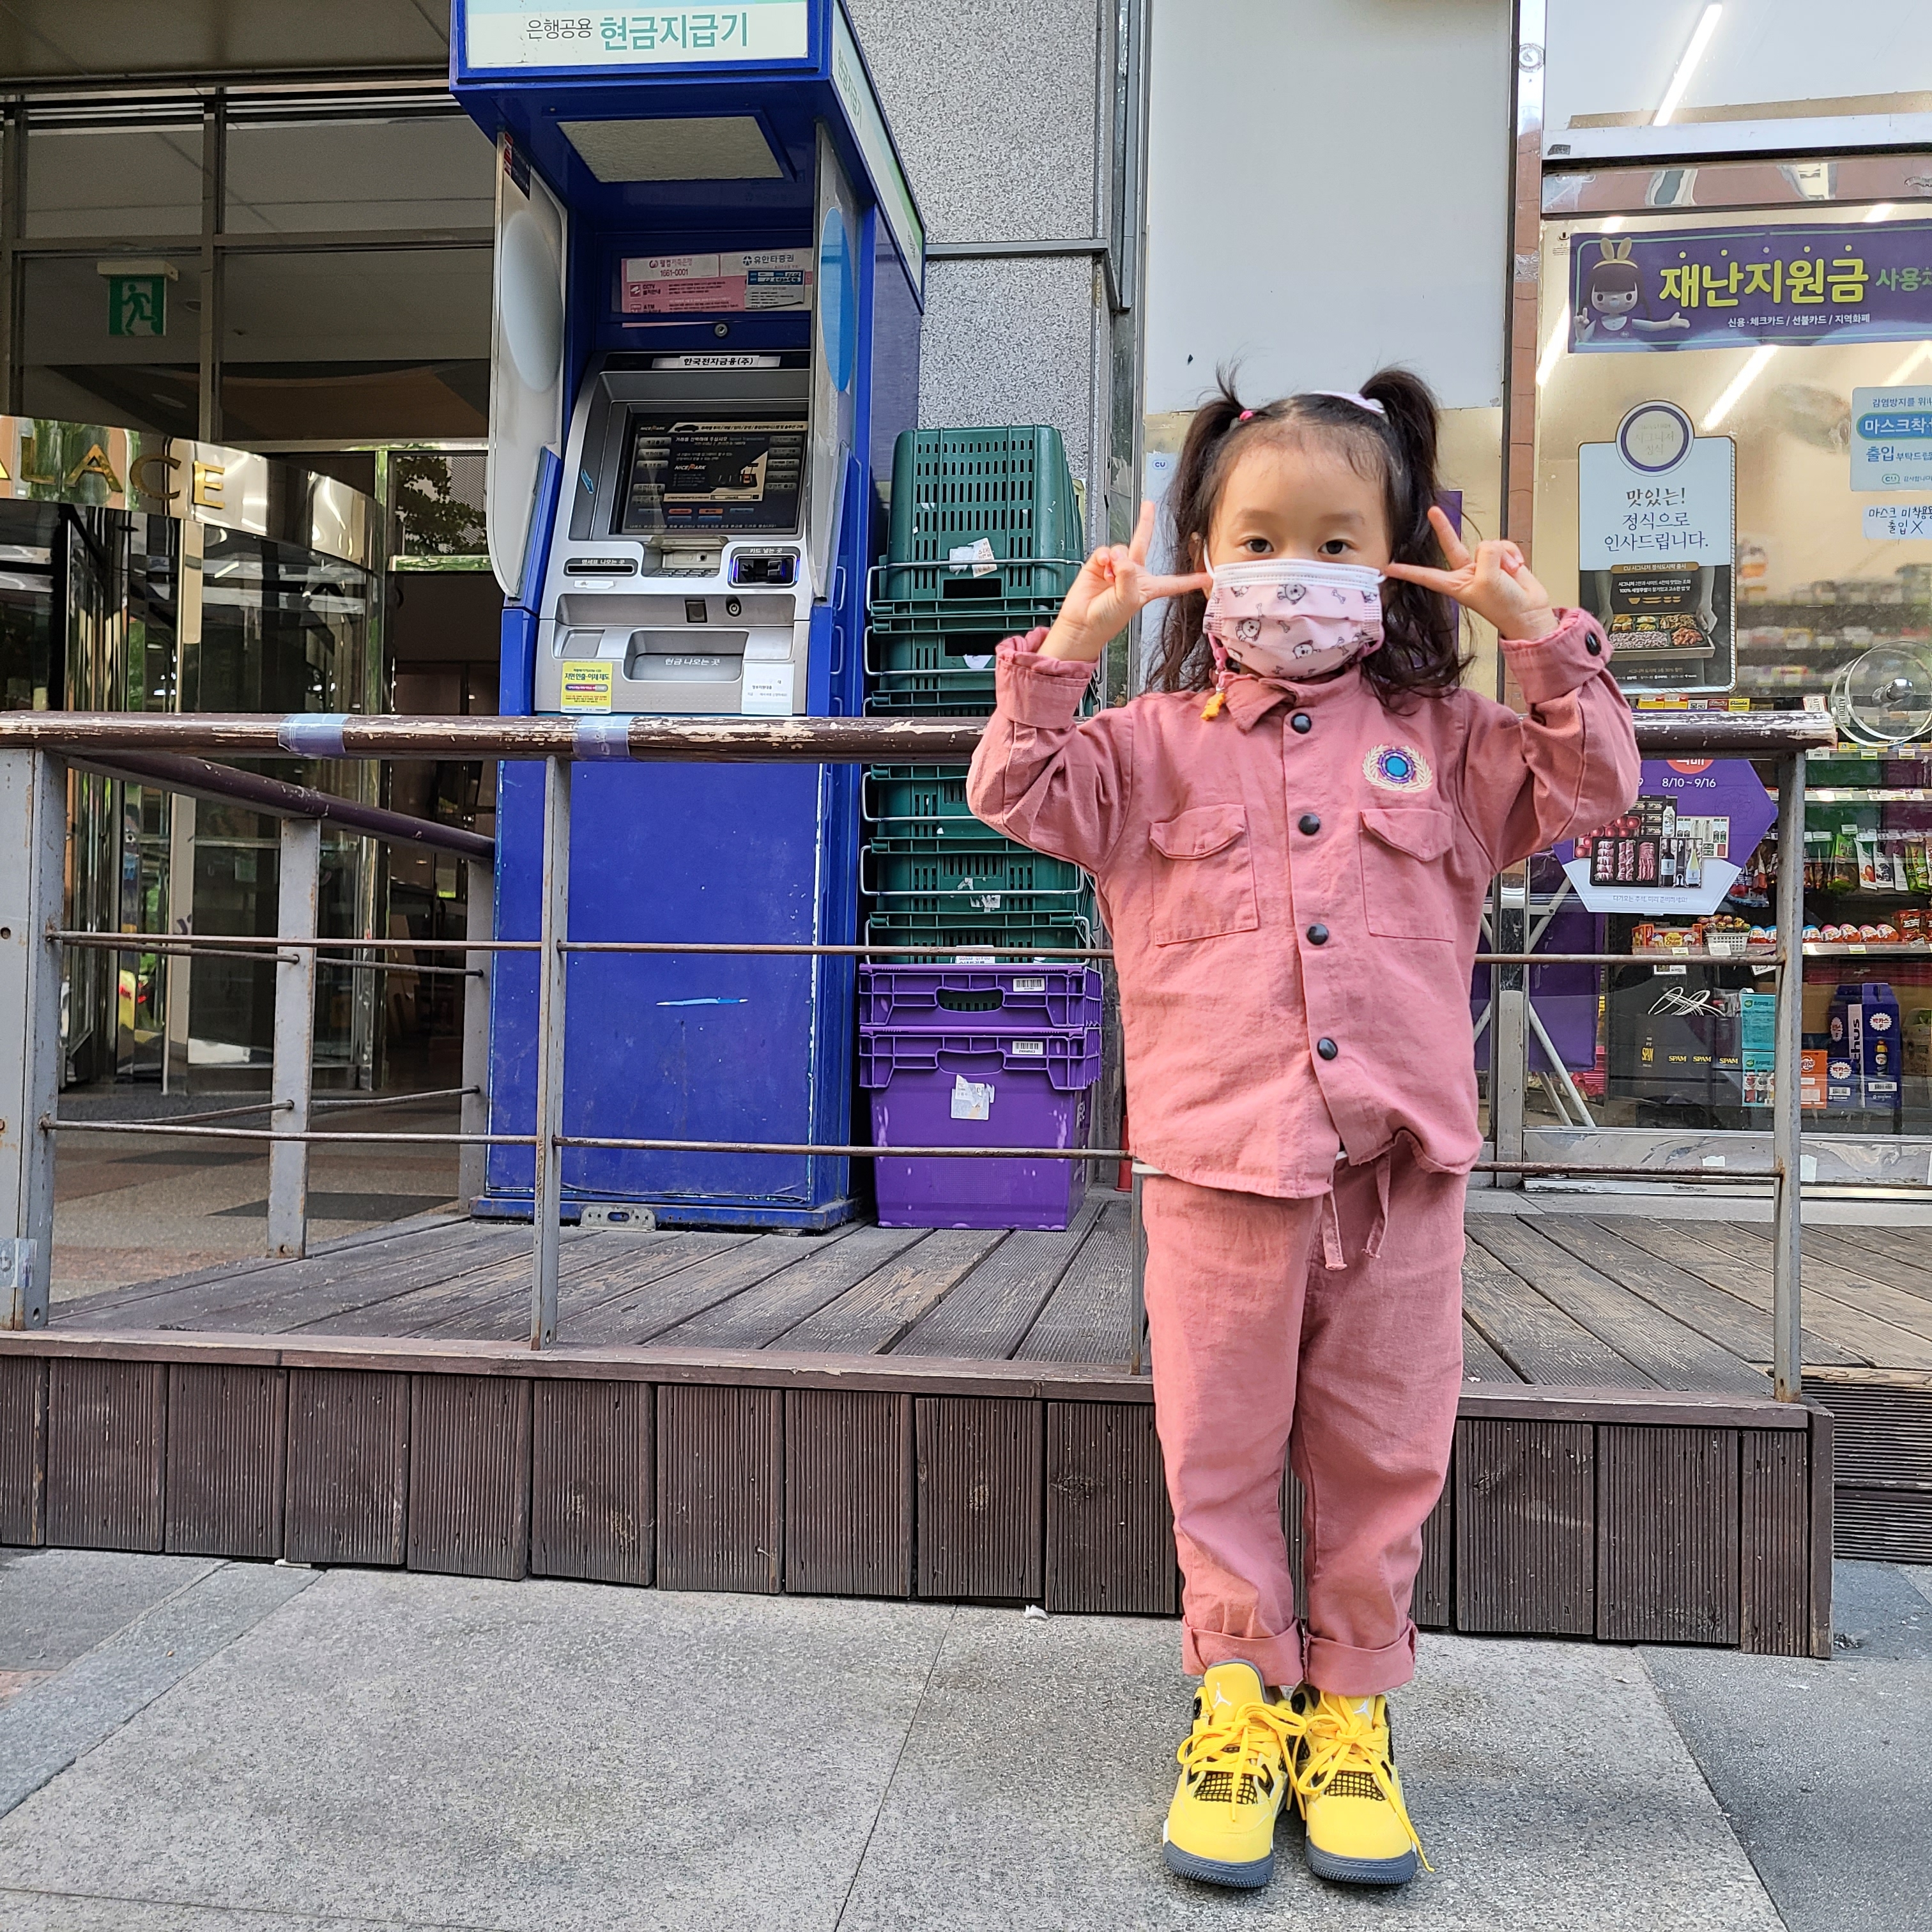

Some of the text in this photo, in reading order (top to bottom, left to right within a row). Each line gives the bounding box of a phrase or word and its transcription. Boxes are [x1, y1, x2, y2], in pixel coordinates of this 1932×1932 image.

[526, 12, 748, 51] 은행공용 현금지급기
[753, 254, 794, 264] 유안타증권
[660, 268, 688, 277] 1661-0001
[1659, 257, 1869, 309] 재난지원금
[1792, 315, 1827, 326] 선불카드
[1834, 312, 1871, 325] 지역화폐
[684, 358, 754, 366] 한국전자금융(주)
[1873, 397, 1915, 408] 감염방지를
[1866, 446, 1894, 462] 출입
[1626, 487, 1685, 509] 맛있는!
[1869, 507, 1896, 518] 마스크
[1622, 512, 1691, 530] 정식으로
[1887, 519, 1908, 535] 출입
[1604, 531, 1709, 552] 인사드립니다.
[1641, 1048, 1653, 1061] SPAM
